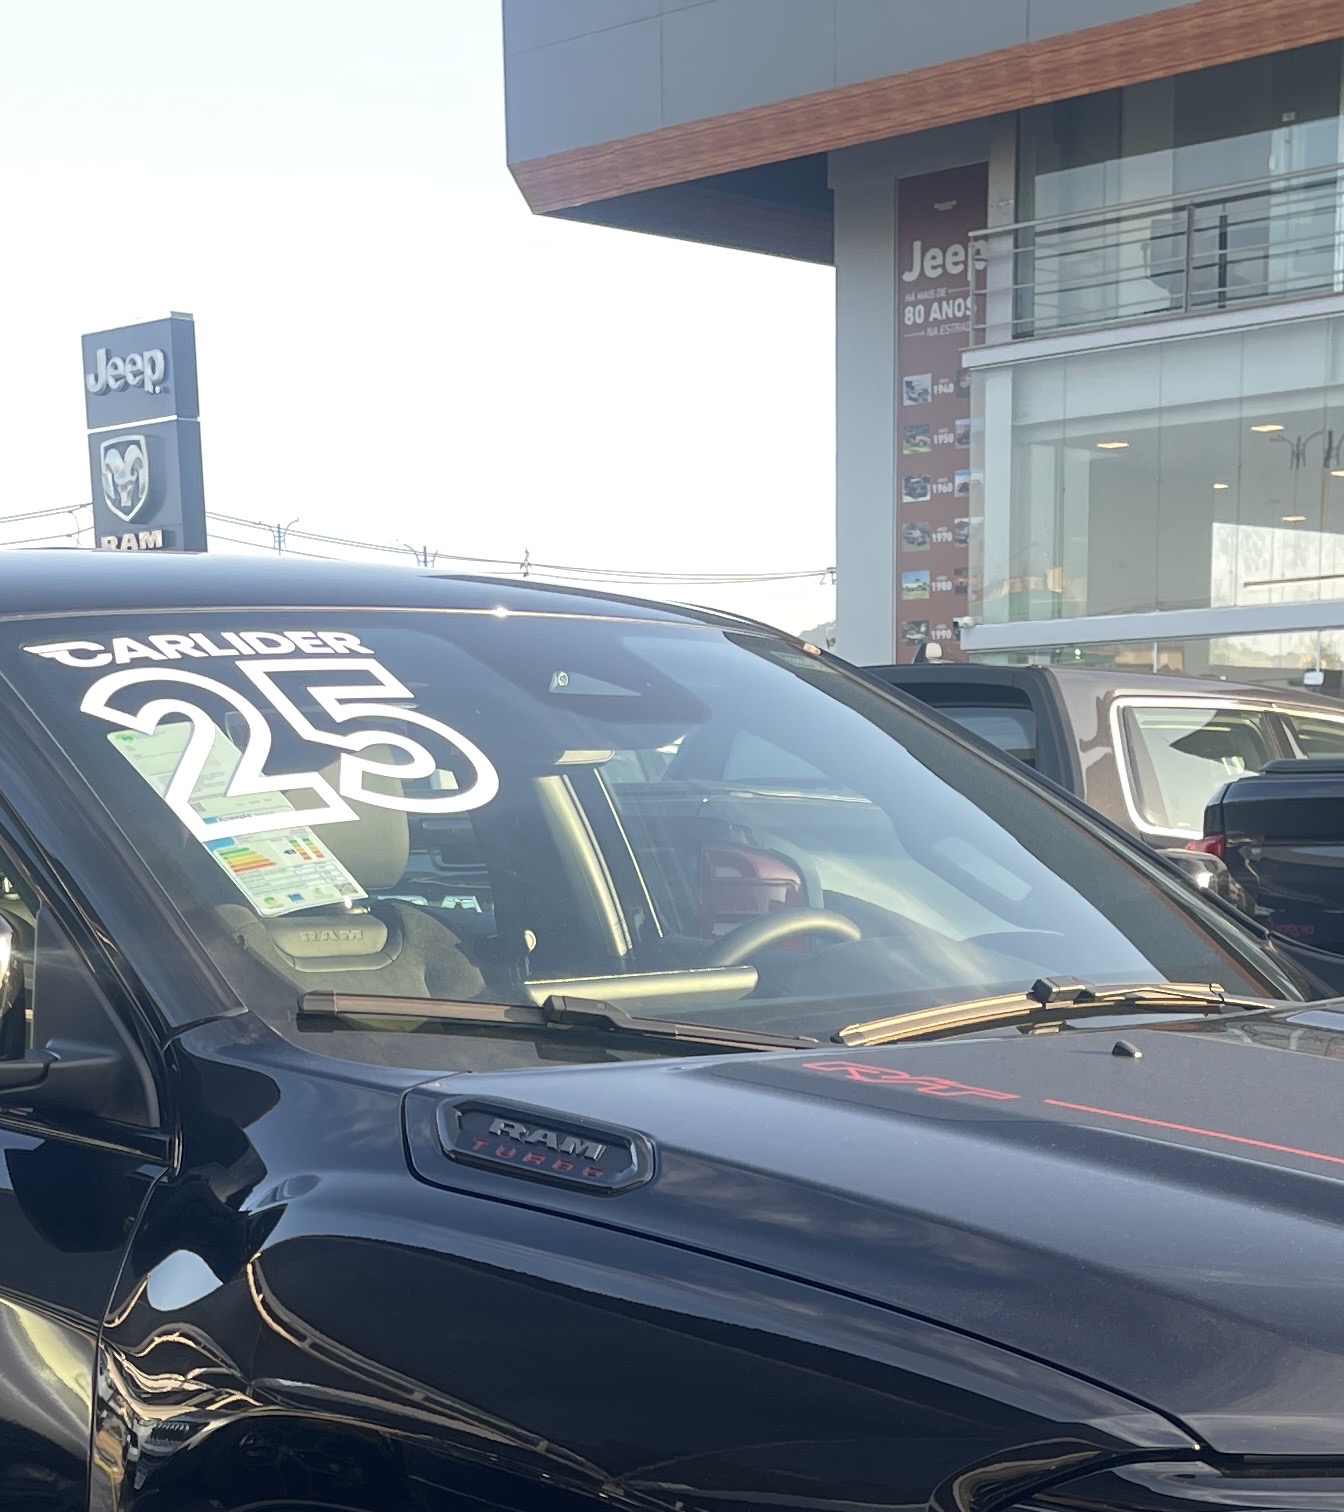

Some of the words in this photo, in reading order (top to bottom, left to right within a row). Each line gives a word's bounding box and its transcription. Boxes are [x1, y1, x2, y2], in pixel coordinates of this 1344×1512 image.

[902, 240, 988, 282] Jeep
[904, 305, 924, 325] 80
[86, 347, 165, 394] Jeep
[101, 529, 163, 550] RAM
[22, 631, 375, 667] CARLIDER
[80, 658, 500, 842] 25
[299, 928, 364, 941] RAM
[472, 1137, 605, 1178] TURBO
[489, 1118, 607, 1161] RAM
